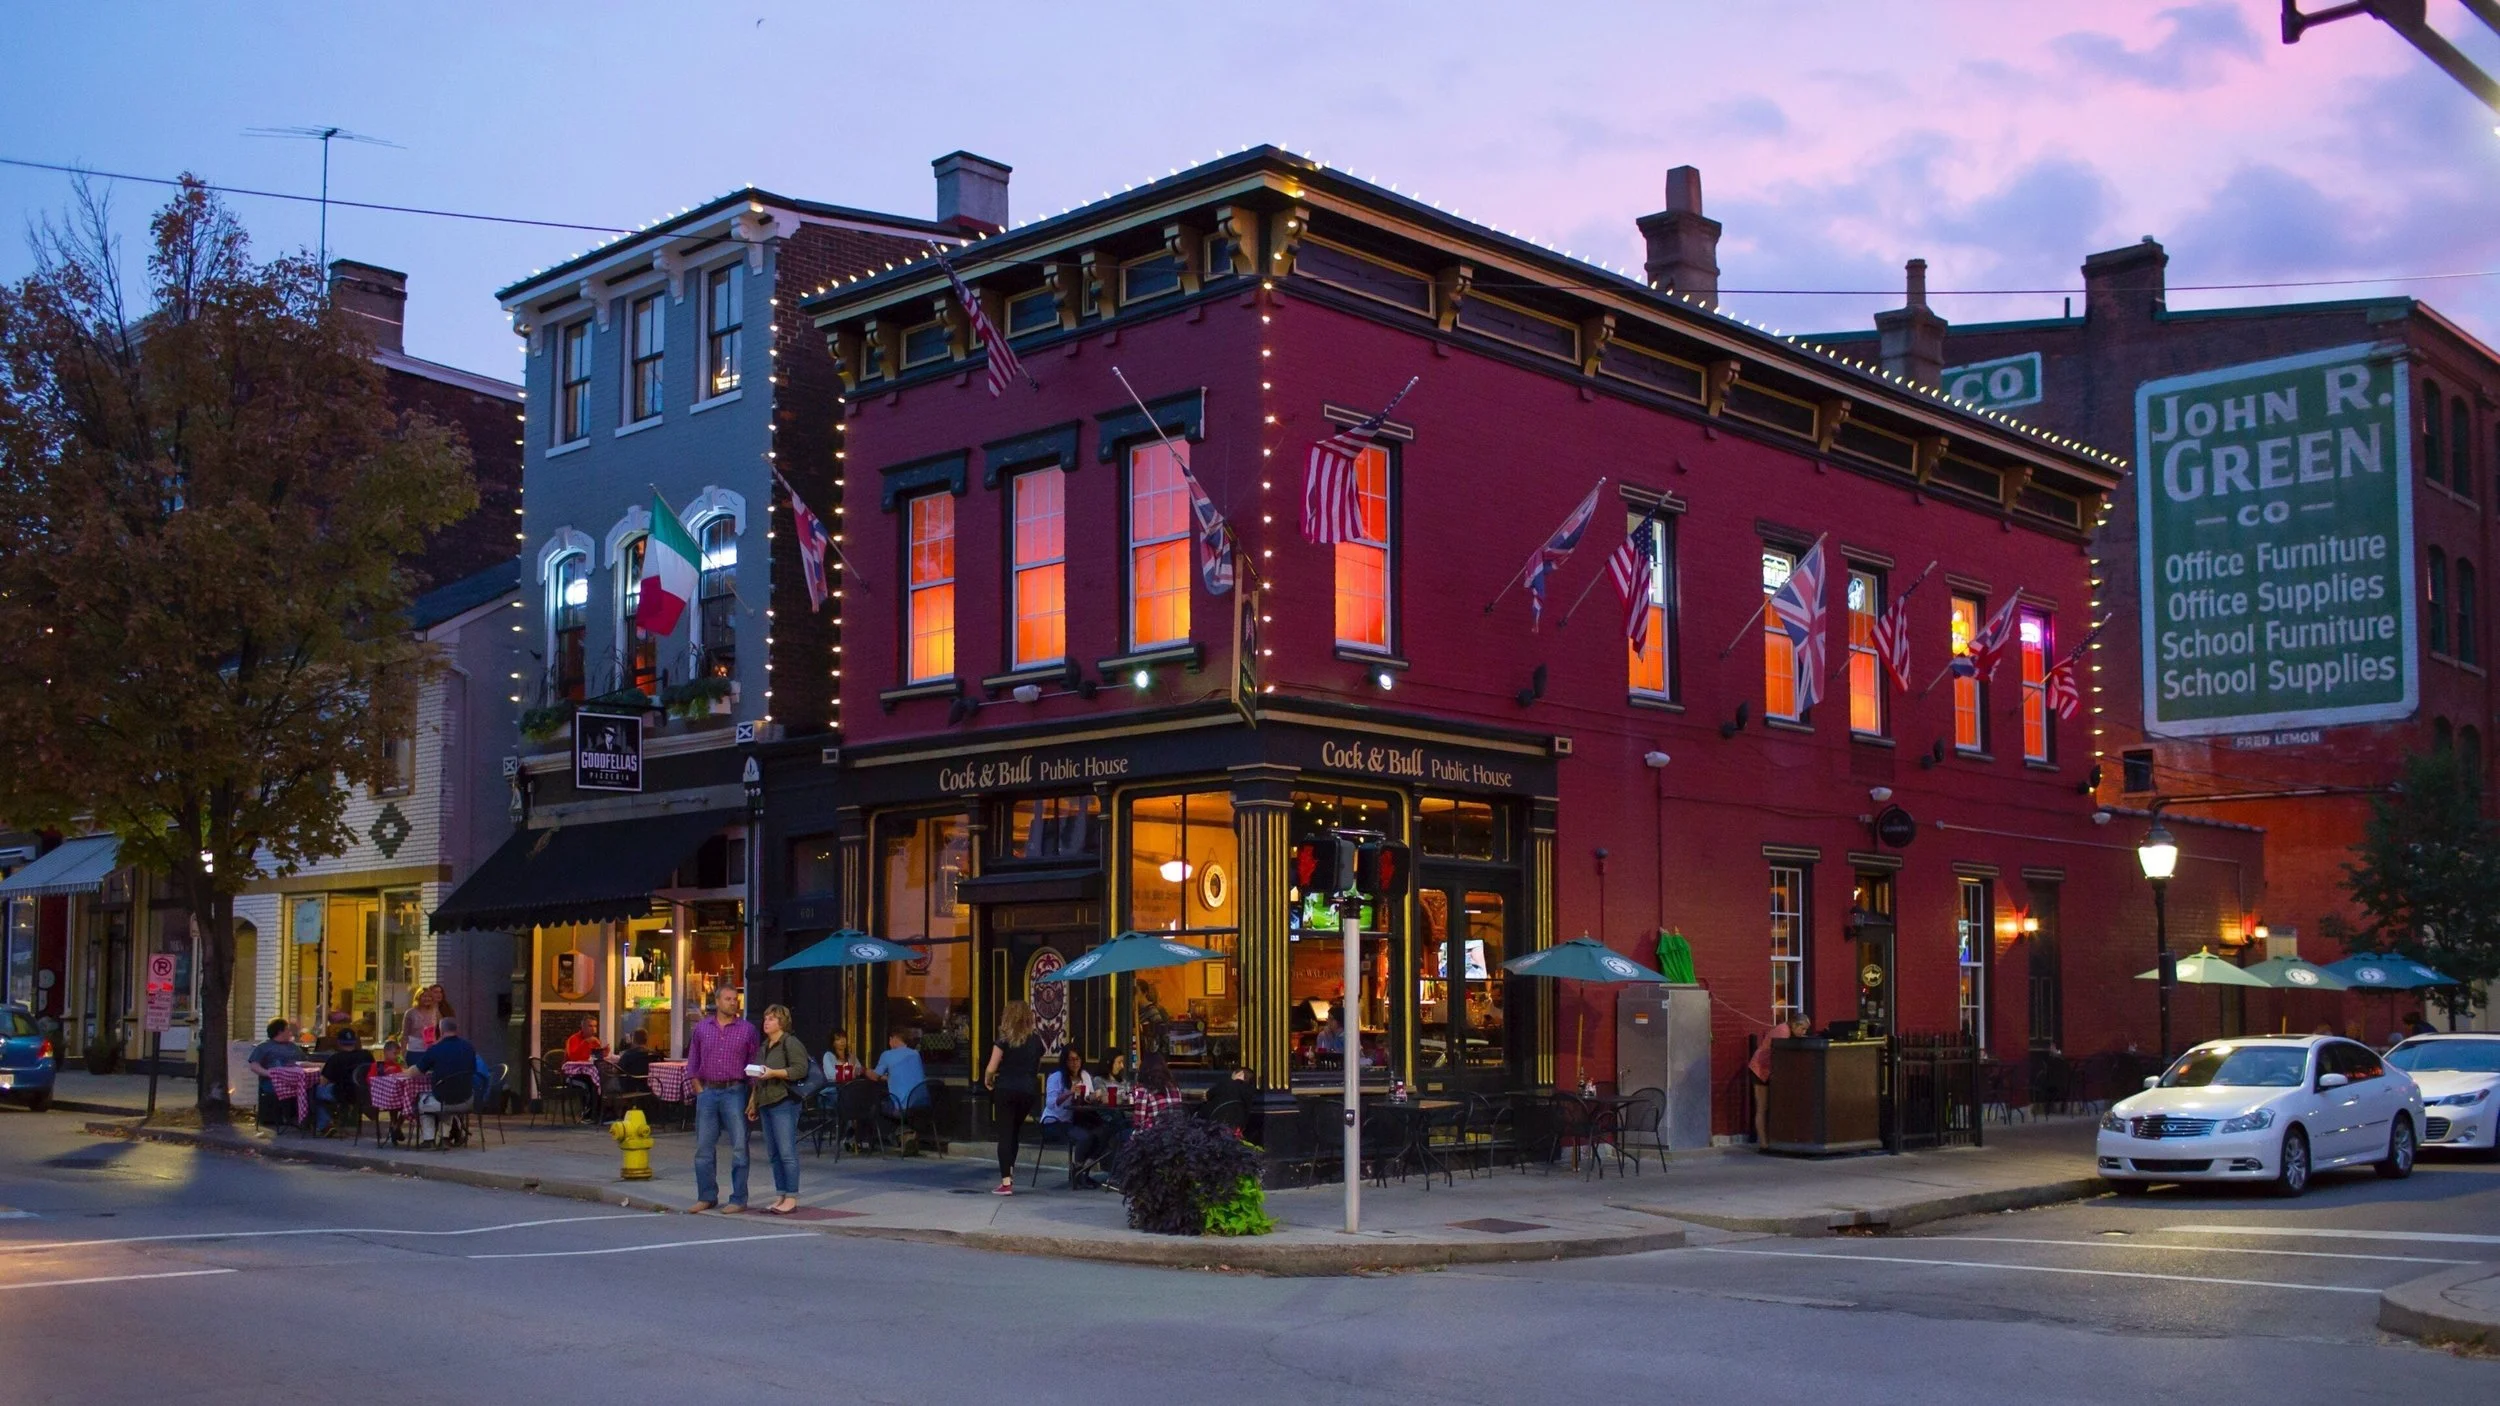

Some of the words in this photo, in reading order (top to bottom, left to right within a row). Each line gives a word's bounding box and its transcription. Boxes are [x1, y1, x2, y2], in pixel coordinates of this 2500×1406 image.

[1950, 366, 2024, 405] CO
[2151, 386, 2298, 444] JOHN
[2323, 363, 2393, 416] R.
[2163, 423, 2384, 502] GREEN
[2236, 500, 2290, 526] CO
[2165, 551, 2244, 584] Office
[2256, 534, 2387, 573] Furniture
[2168, 589, 2248, 622] Office
[2258, 572, 2384, 615] Supplies
[2162, 623, 2254, 661] School
[2266, 613, 2395, 652] Furniture
[2163, 662, 2256, 700] School
[2268, 652, 2396, 694] Supplies
[581, 752, 638, 772] GOODFELLAS
[2236, 735, 2270, 748] FRED
[2275, 731, 2320, 746] LEMON
[589, 771, 630, 781] PIZZERIA
[939, 761, 976, 792] Cock
[979, 763, 995, 789] &
[998, 754, 1033, 786] Bull
[1040, 758, 1081, 782] Public
[1084, 756, 1129, 777] House
[1322, 740, 1365, 770] Cock
[1368, 746, 1385, 773] &
[1388, 748, 1424, 777] Bull
[1431, 758, 1470, 783] Public
[1473, 764, 1512, 788] House
